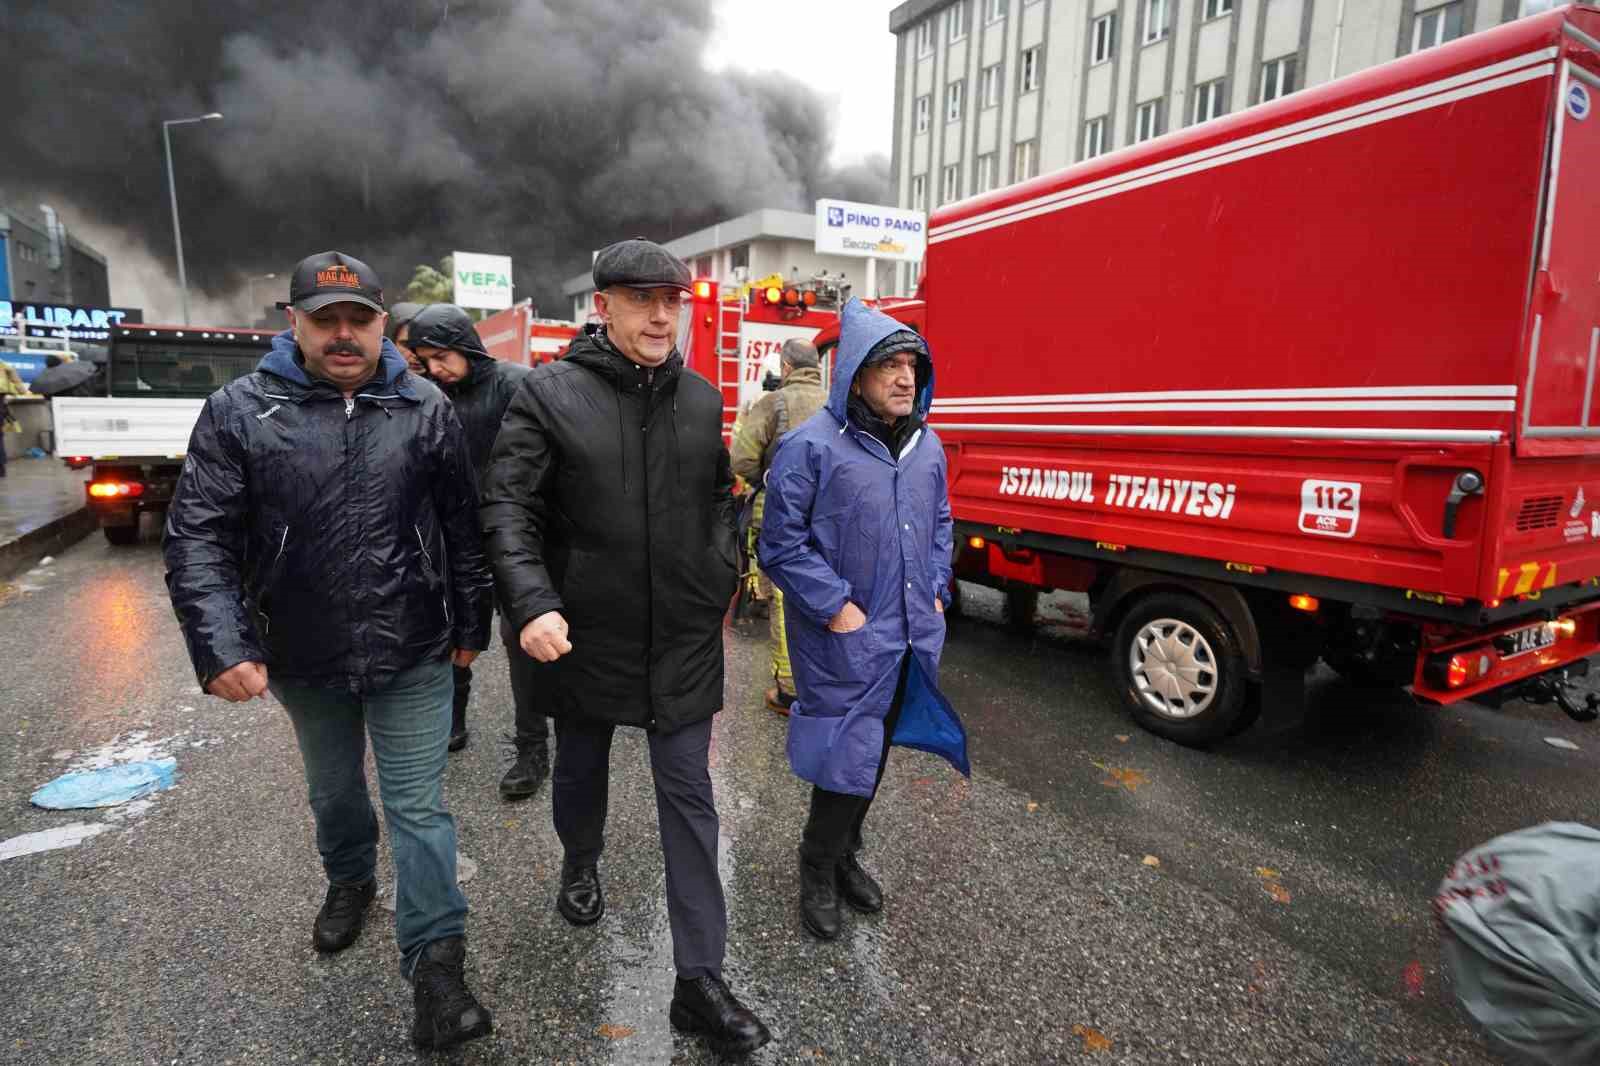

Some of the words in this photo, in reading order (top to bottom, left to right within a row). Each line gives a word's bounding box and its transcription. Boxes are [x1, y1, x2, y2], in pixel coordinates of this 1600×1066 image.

[884, 218, 922, 233] PANO
[458, 271, 508, 288] VEFA
[1314, 486, 1354, 511] 112
